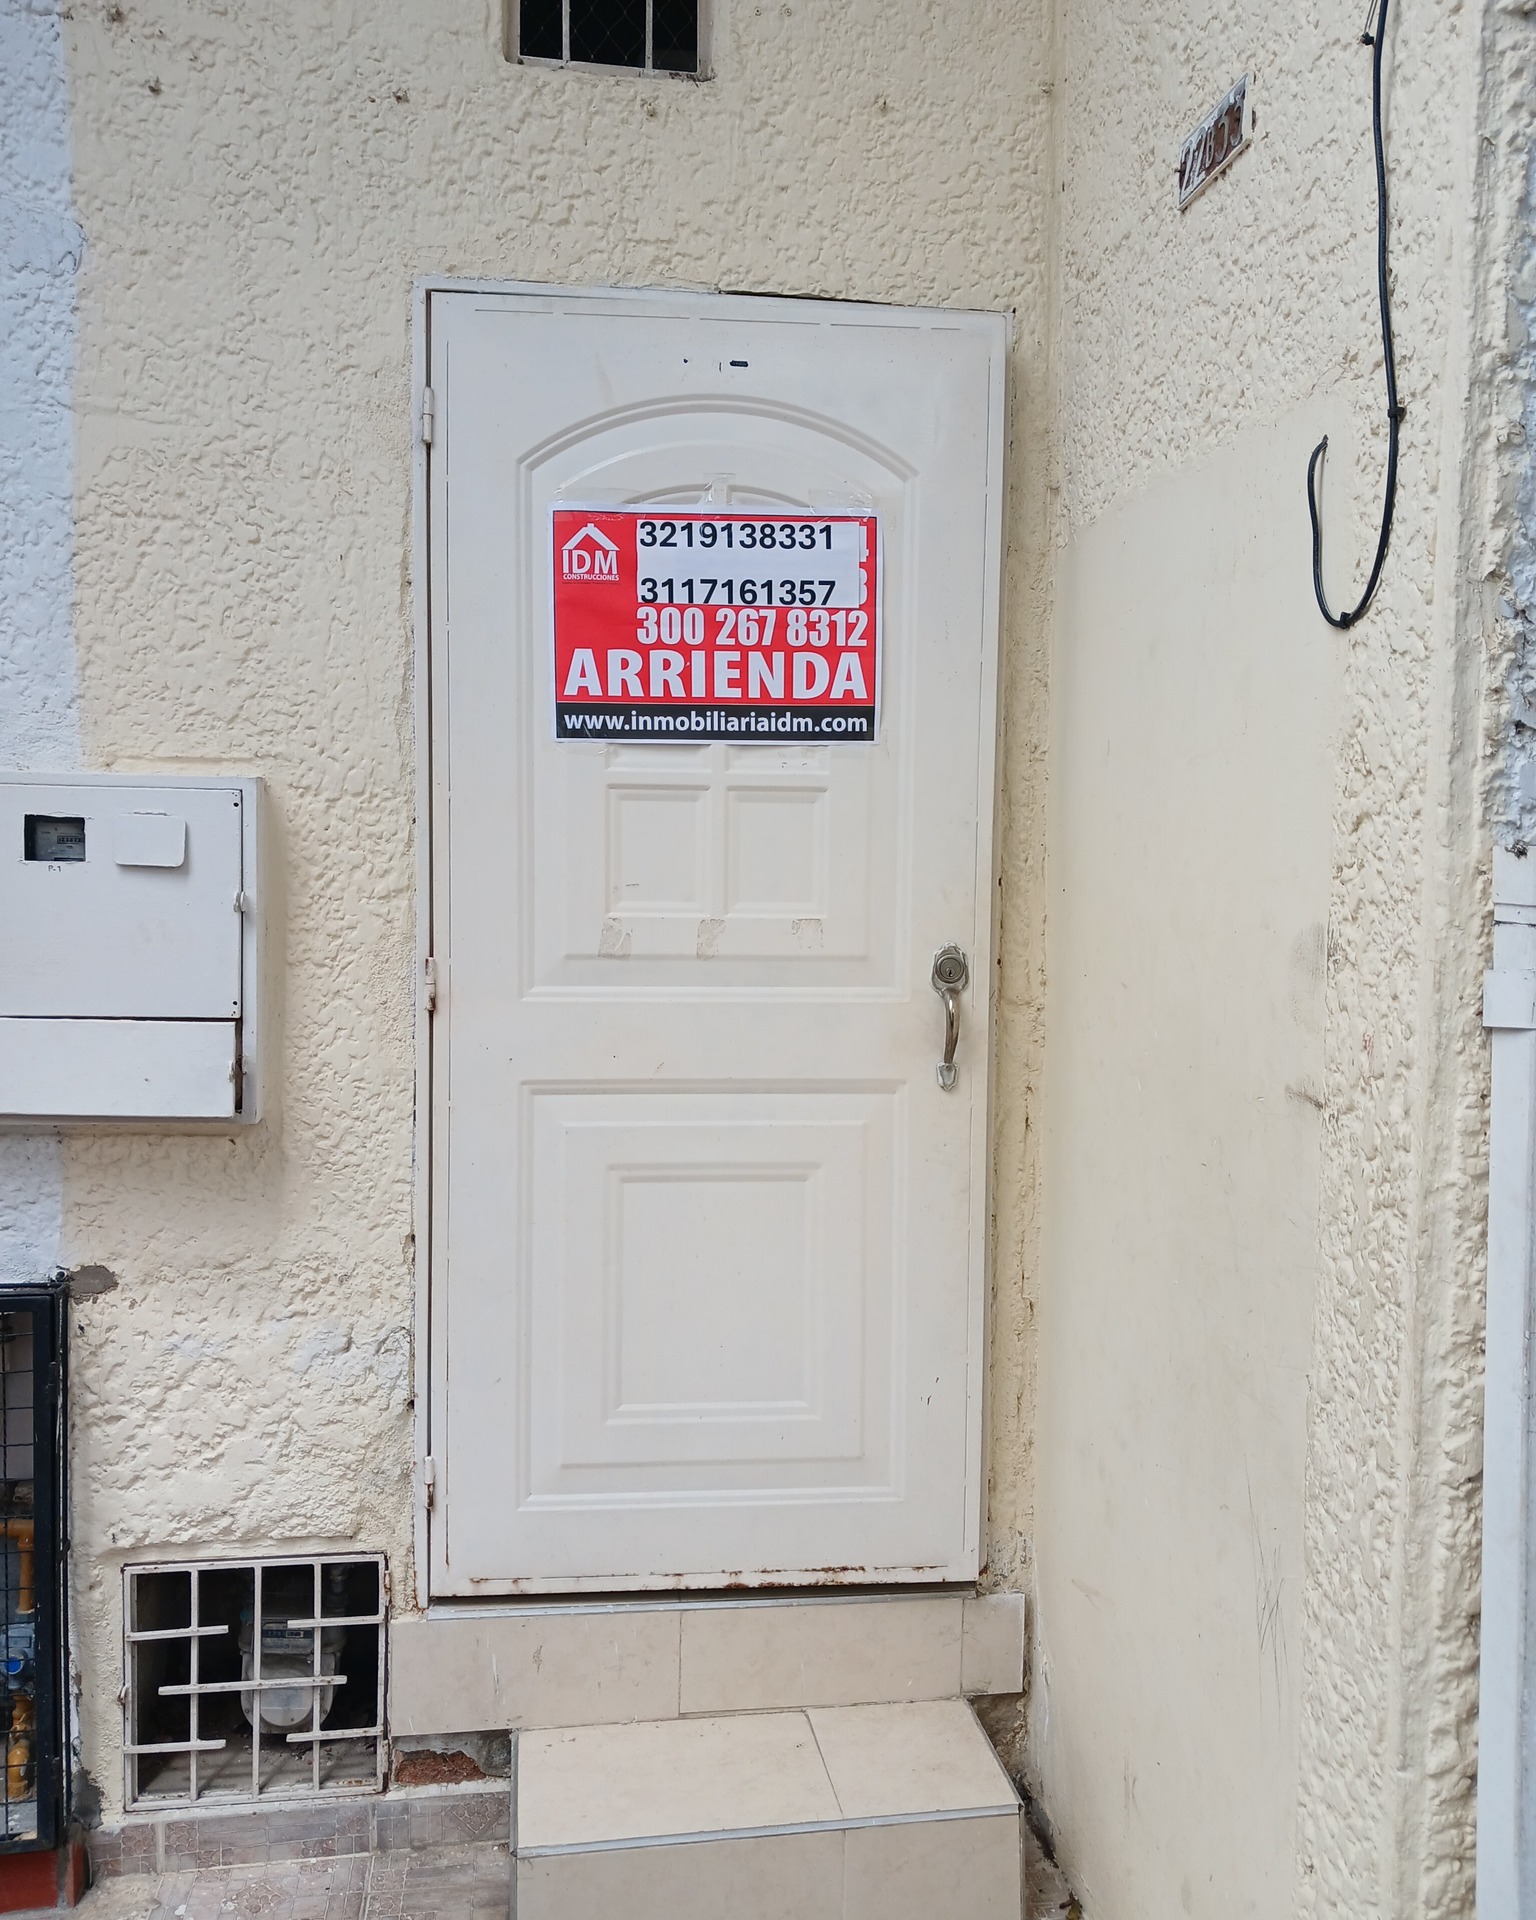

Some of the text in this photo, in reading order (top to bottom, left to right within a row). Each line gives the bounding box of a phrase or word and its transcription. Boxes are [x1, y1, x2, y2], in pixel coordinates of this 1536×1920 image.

[640, 520, 832, 550] 3219138331
[562, 549, 619, 575] IDM
[562, 573, 620, 581] CONSTRUCCIONES
[640, 577, 836, 606] 3117161357
[636, 606, 869, 648] 300 267 8312
[563, 648, 869, 699] ARRIENDA
[564, 709, 868, 733] www.inmobiliariaidm.com
